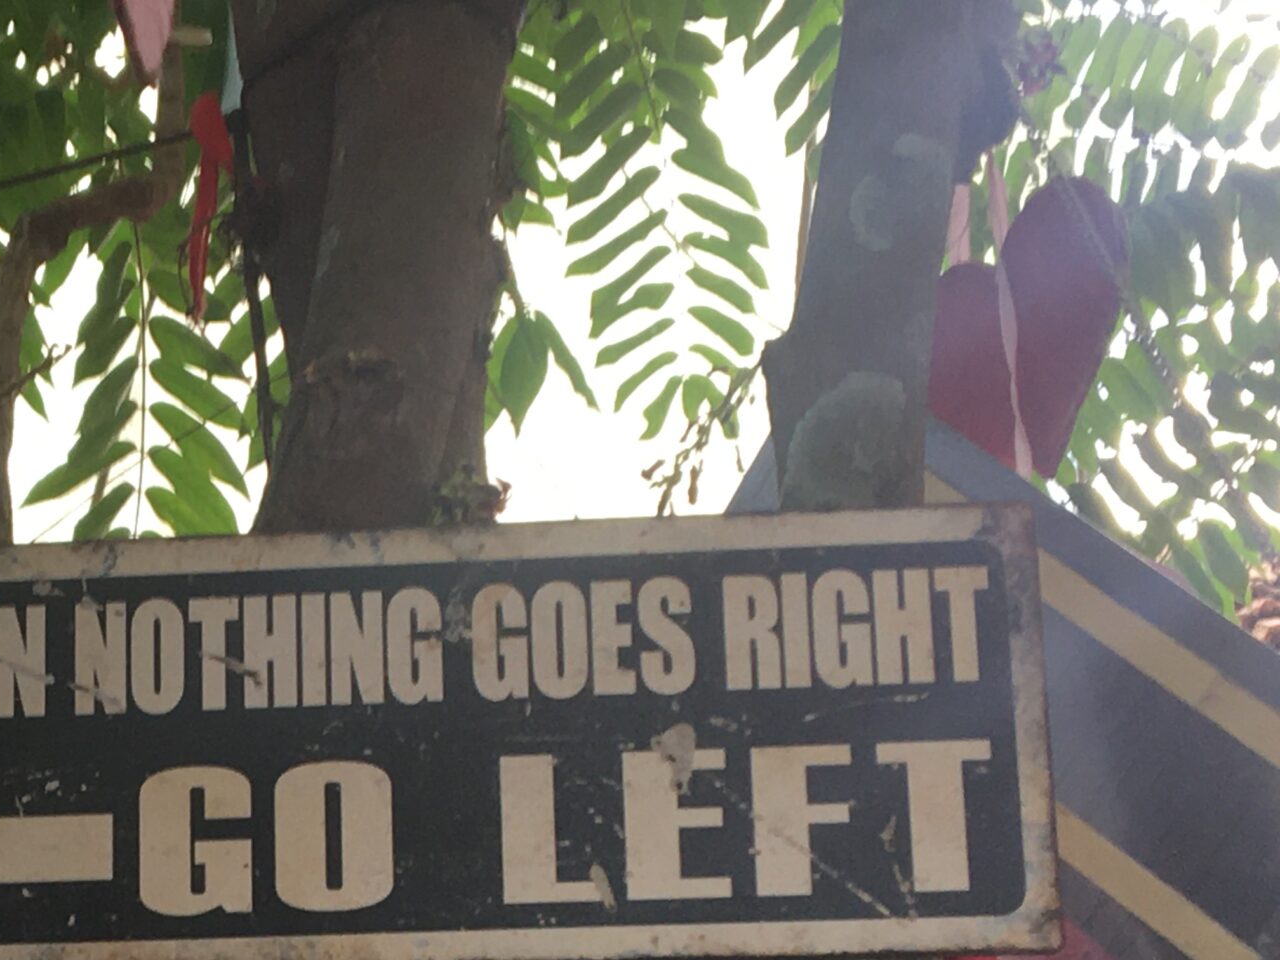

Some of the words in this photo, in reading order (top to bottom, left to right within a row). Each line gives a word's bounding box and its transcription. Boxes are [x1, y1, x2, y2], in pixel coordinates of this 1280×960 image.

[74, 586, 444, 717] NOTHING
[472, 576, 697, 702] GOES
[722, 564, 990, 692] RIGHT
[138, 760, 395, 918] GO
[499, 738, 993, 906] LEFT
